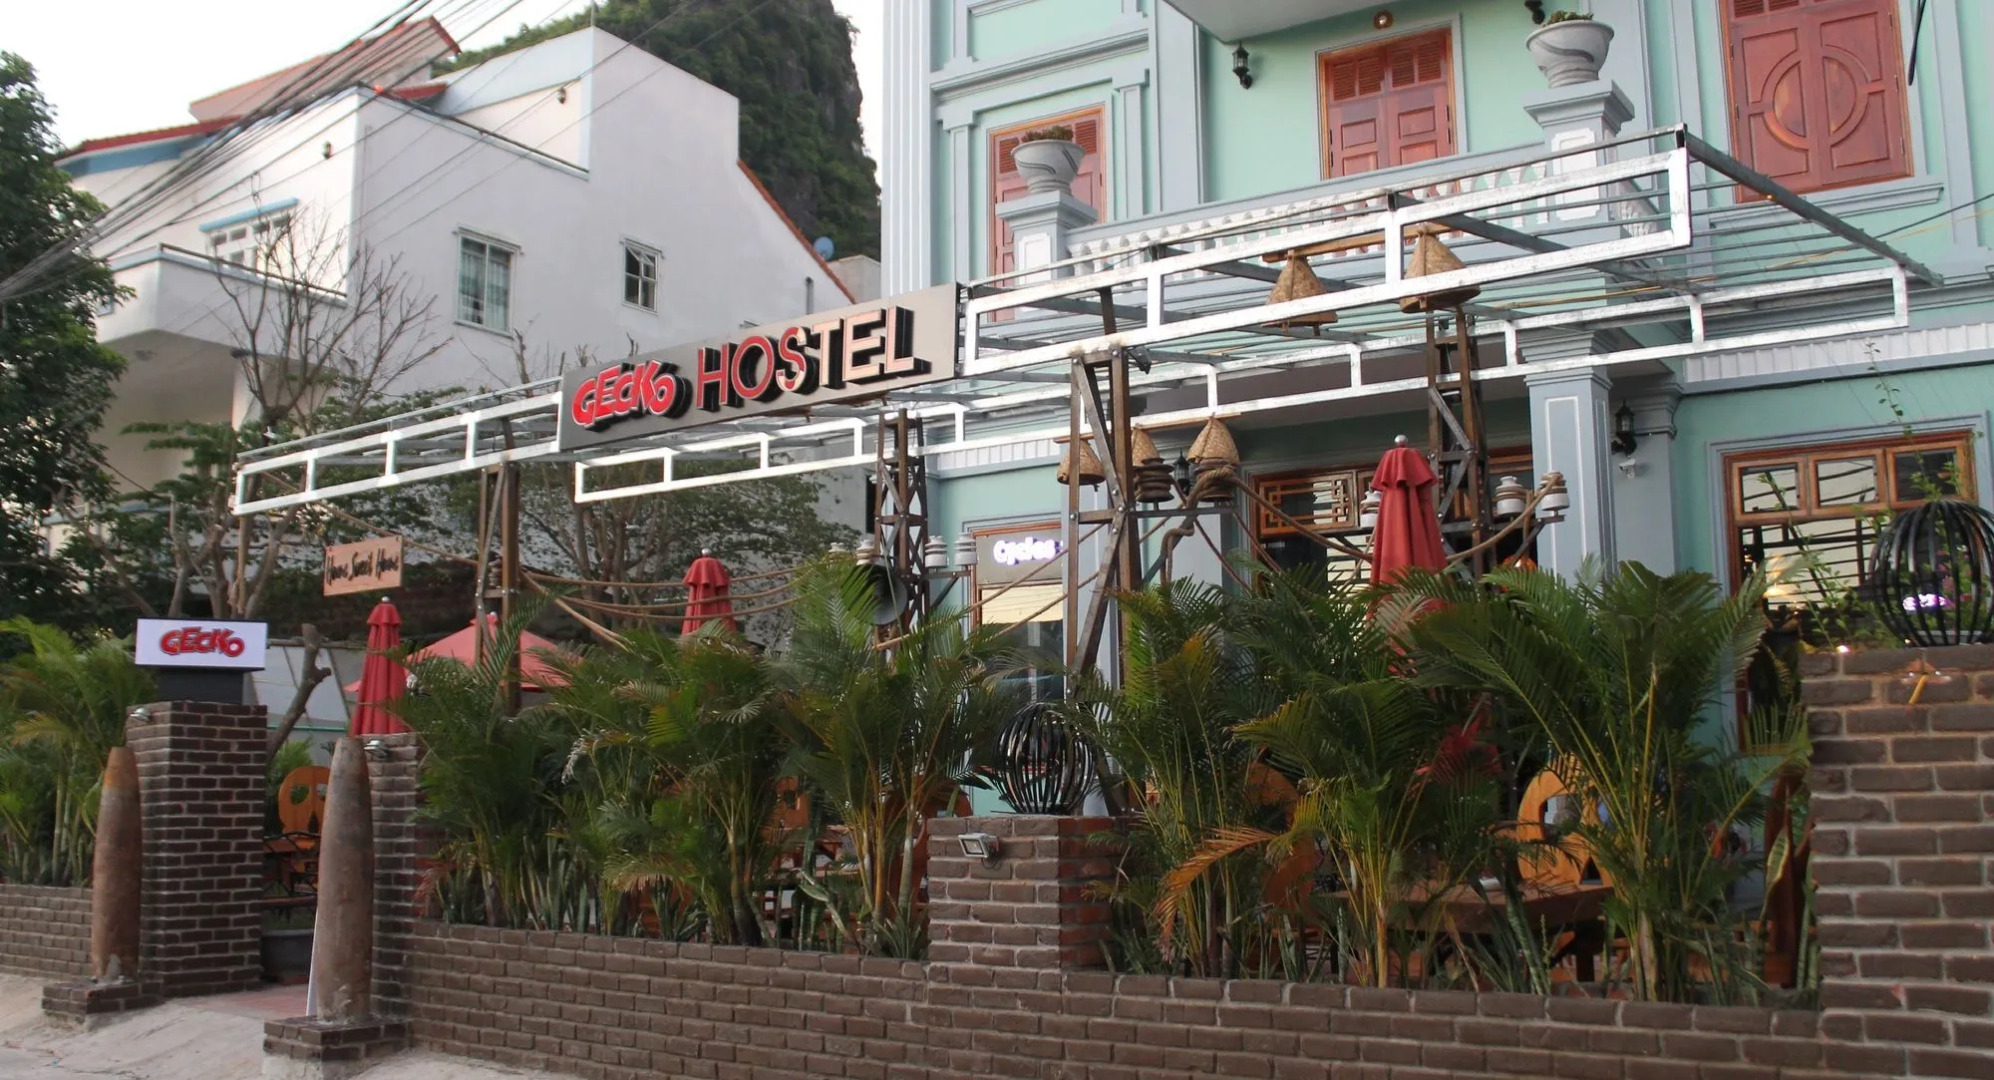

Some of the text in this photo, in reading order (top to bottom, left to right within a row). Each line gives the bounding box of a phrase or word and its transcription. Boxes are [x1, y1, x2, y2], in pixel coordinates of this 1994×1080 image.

[571, 305, 921, 430] GECKO HOSTEL
[326, 548, 399, 586] Home Sweet Home
[160, 626, 245, 657] GECKO
